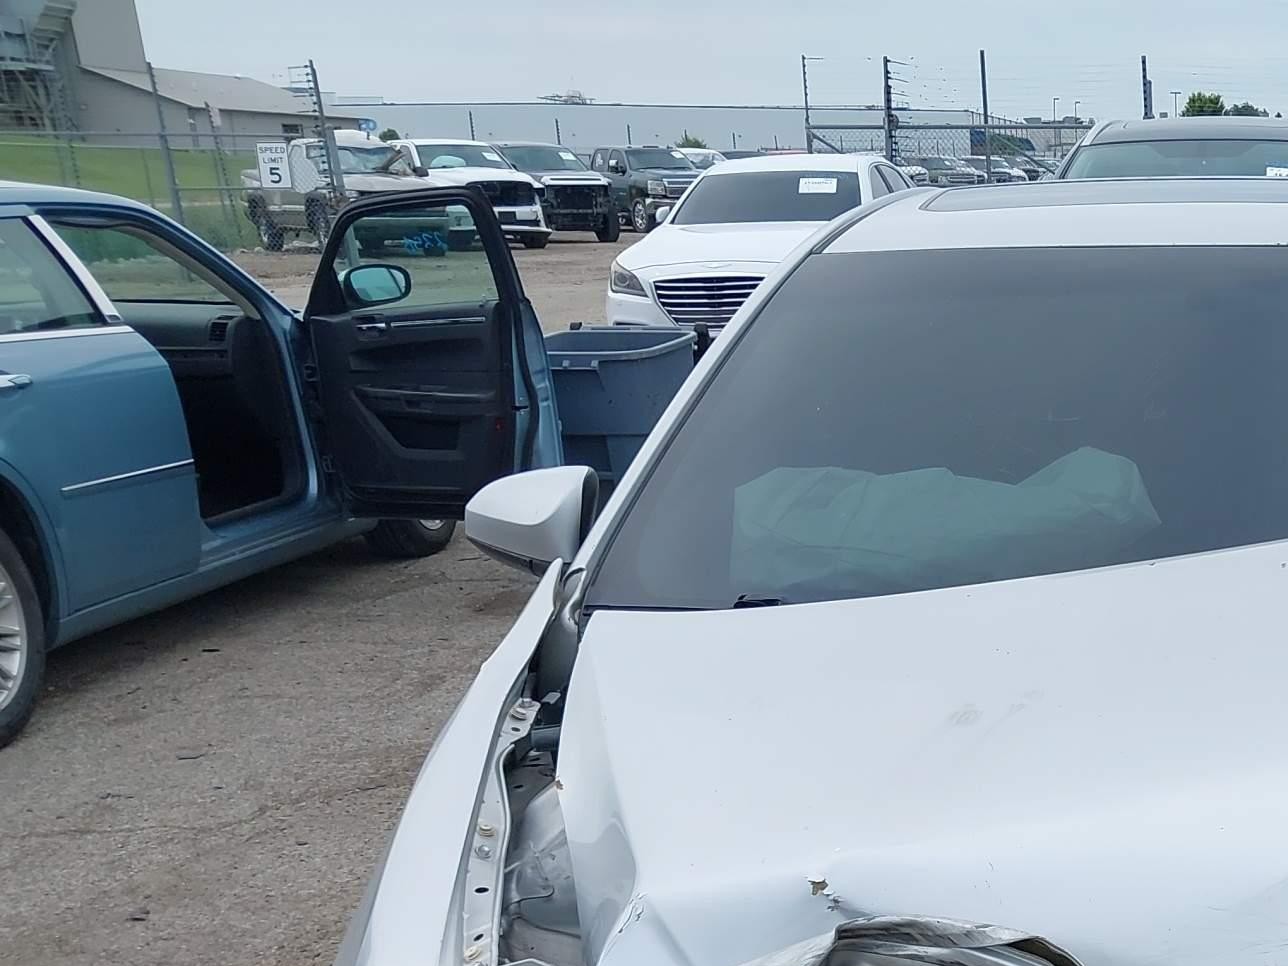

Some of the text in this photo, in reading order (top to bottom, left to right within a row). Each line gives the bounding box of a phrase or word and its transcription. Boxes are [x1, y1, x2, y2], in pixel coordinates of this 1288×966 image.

[258, 146, 286, 154] SPEED
[262, 156, 284, 164] LIMIT
[269, 166, 282, 184] 5
